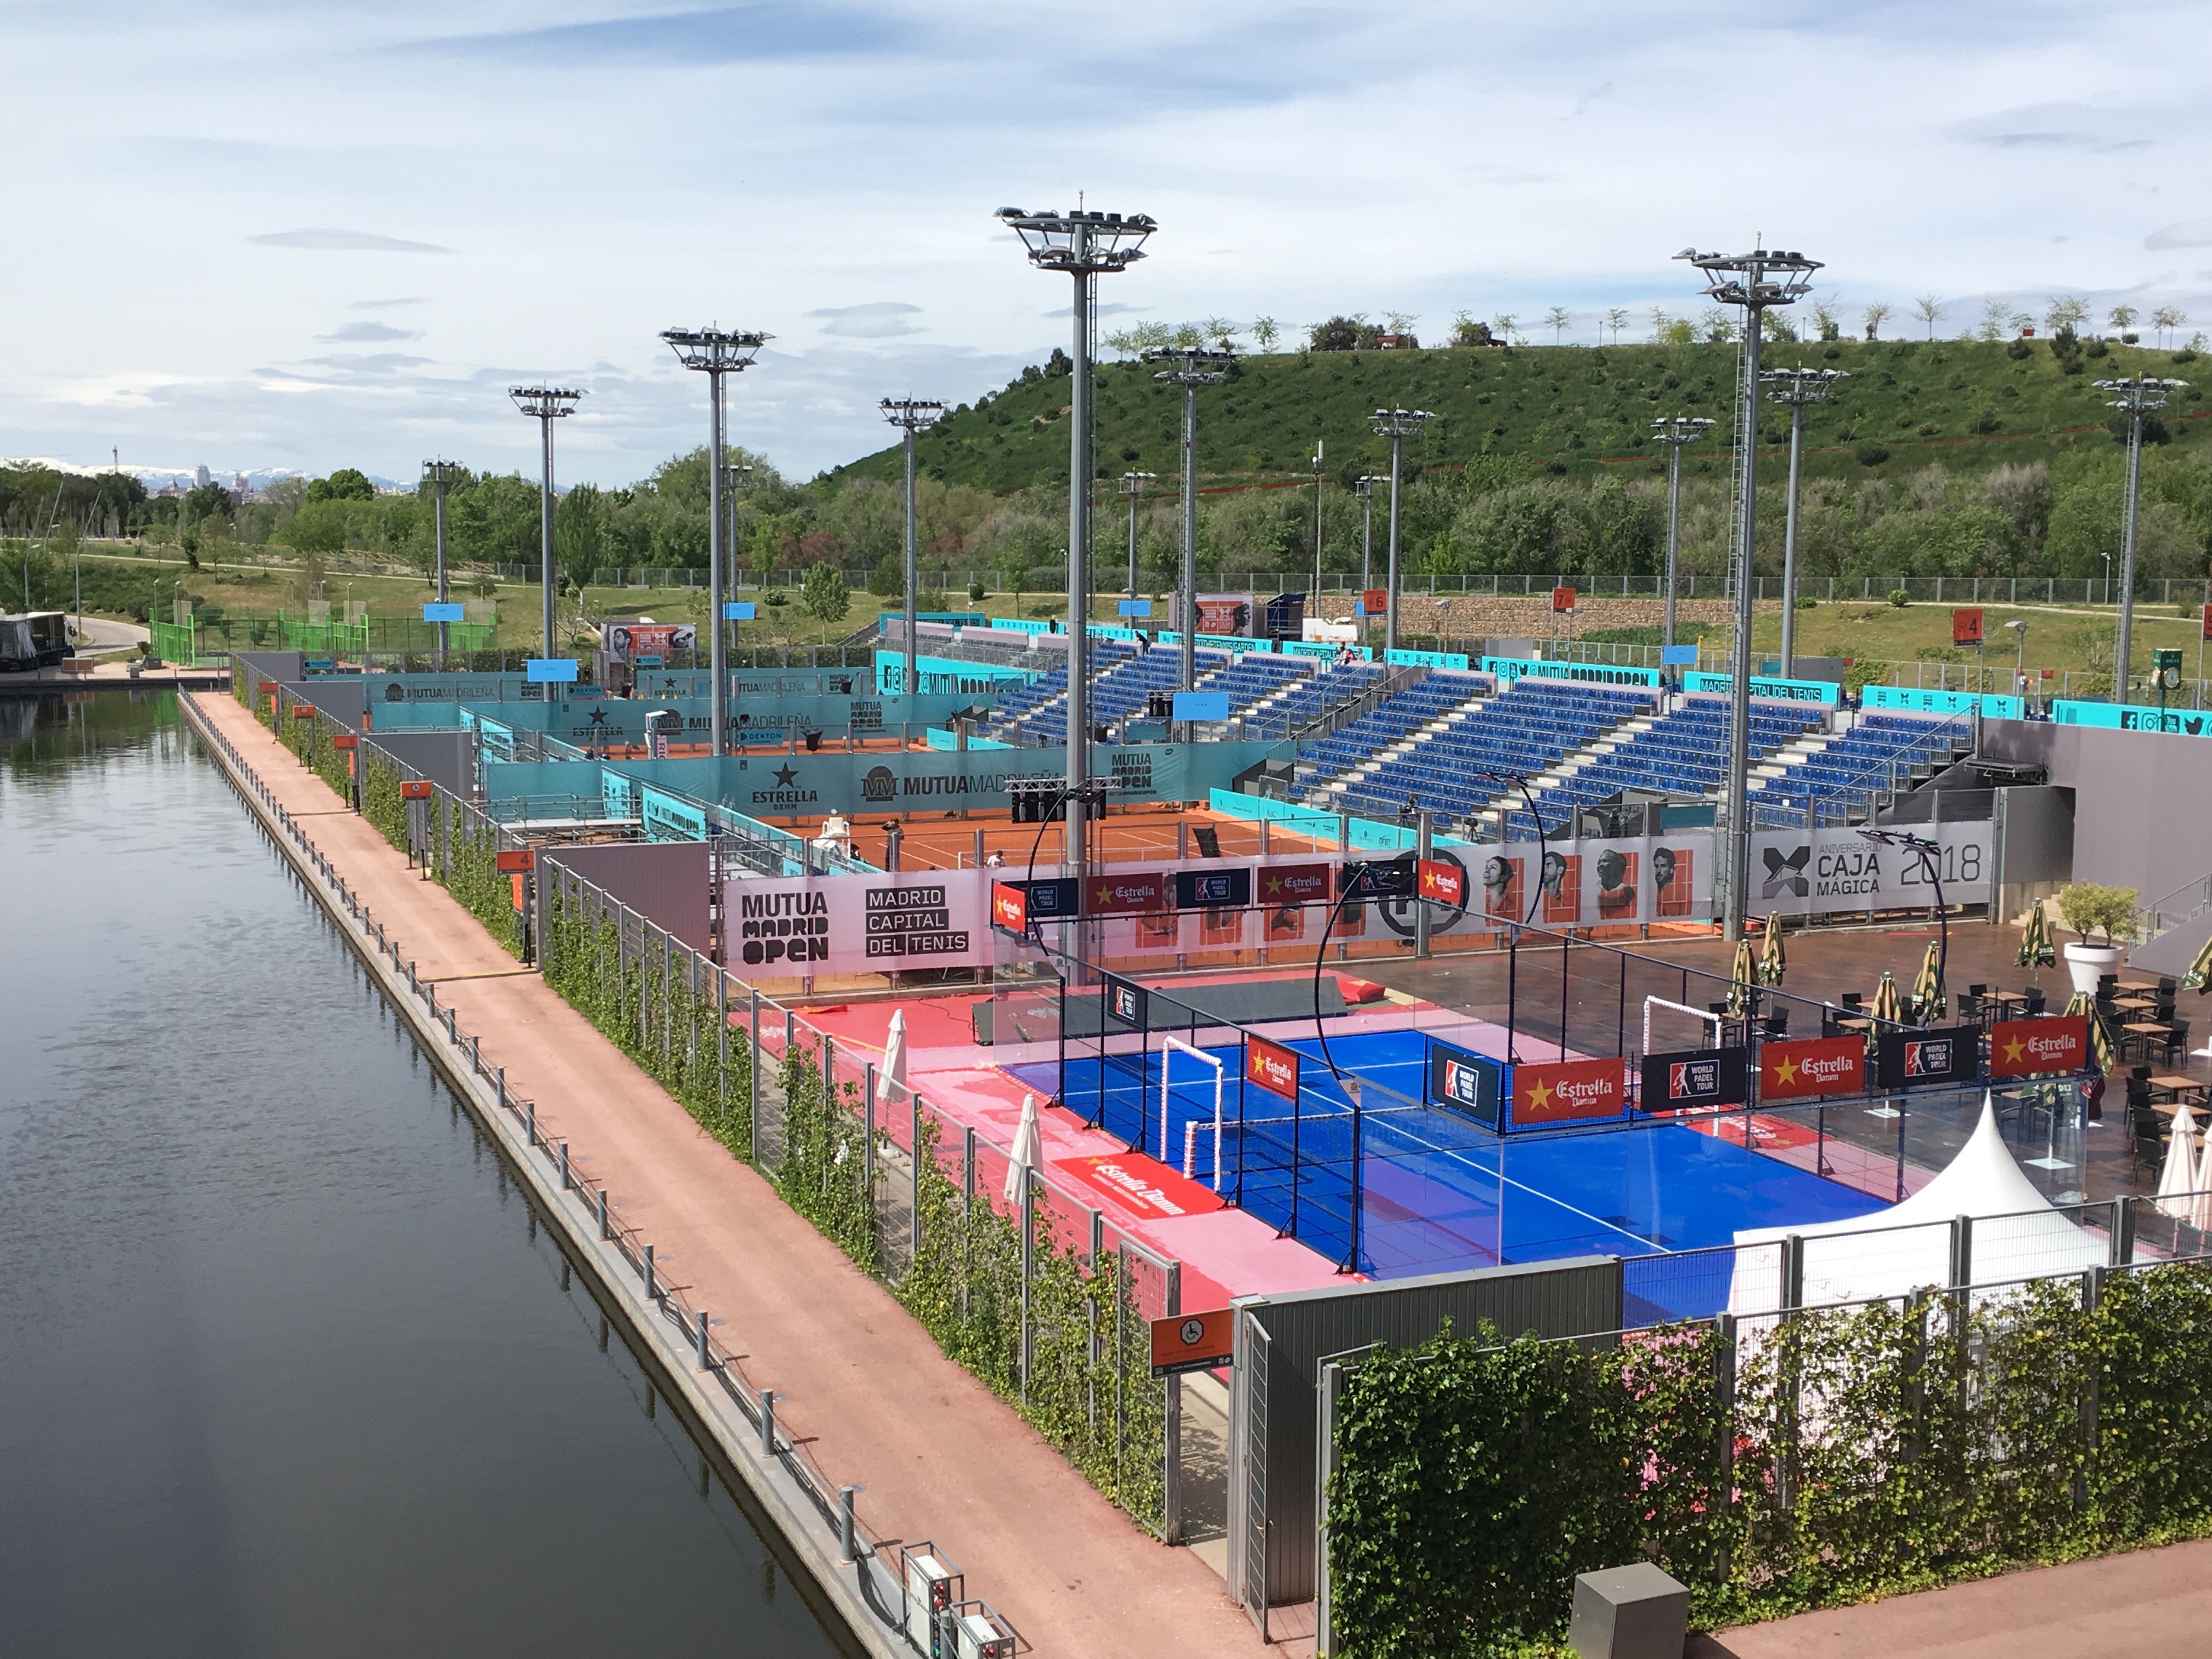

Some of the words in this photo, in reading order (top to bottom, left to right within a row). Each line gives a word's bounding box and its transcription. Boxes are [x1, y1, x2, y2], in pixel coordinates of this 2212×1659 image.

[1376, 596, 1384, 607] 6
[1557, 595, 1564, 606] 7
[1968, 618, 1978, 634] 4
[1792, 687, 1821, 702] TENIS
[851, 701, 882, 711] MUTUA
[1112, 753, 1152, 766] MUTUA
[752, 791, 819, 803] ESTRELLA
[1819, 843, 1882, 854] ANIVERSARIO
[520, 854, 529, 865] 4
[1818, 853, 1881, 878] CAJA
[1901, 844, 1981, 885] 2018
[1284, 875, 1322, 889] Estrella
[1816, 877, 1880, 896] MÁGICA
[1115, 885, 1155, 899] Estrella
[742, 891, 828, 918] MUTUA
[869, 889, 943, 909] MADRID
[742, 916, 828, 939] MADRID
[869, 913, 945, 930] CAPITAL
[742, 936, 828, 965] OPEN
[870, 938, 903, 954] DEL
[911, 934, 967, 950] TENIS
[1926, 1044, 1948, 1054] WORLD
[2028, 1034, 2076, 1053] Estrella
[1928, 1052, 1947, 1062] PADEL
[2041, 1050, 2063, 1060] Damm
[1691, 1064, 1714, 1075] WORLD
[1801, 1055, 1853, 1075] Estrella
[1930, 1059, 1947, 1070] TOUR
[1459, 1069, 1475, 1083] WORLD
[1694, 1073, 1714, 1082] PADEL
[1816, 1072, 1839, 1083] Damm
[1460, 1079, 1474, 1091] PADEL
[1556, 1078, 1613, 1098] Estrella
[1696, 1081, 1714, 1091] TOUR
[1461, 1087, 1474, 1100] TOUR
[1571, 1097, 1598, 1107] Damm
